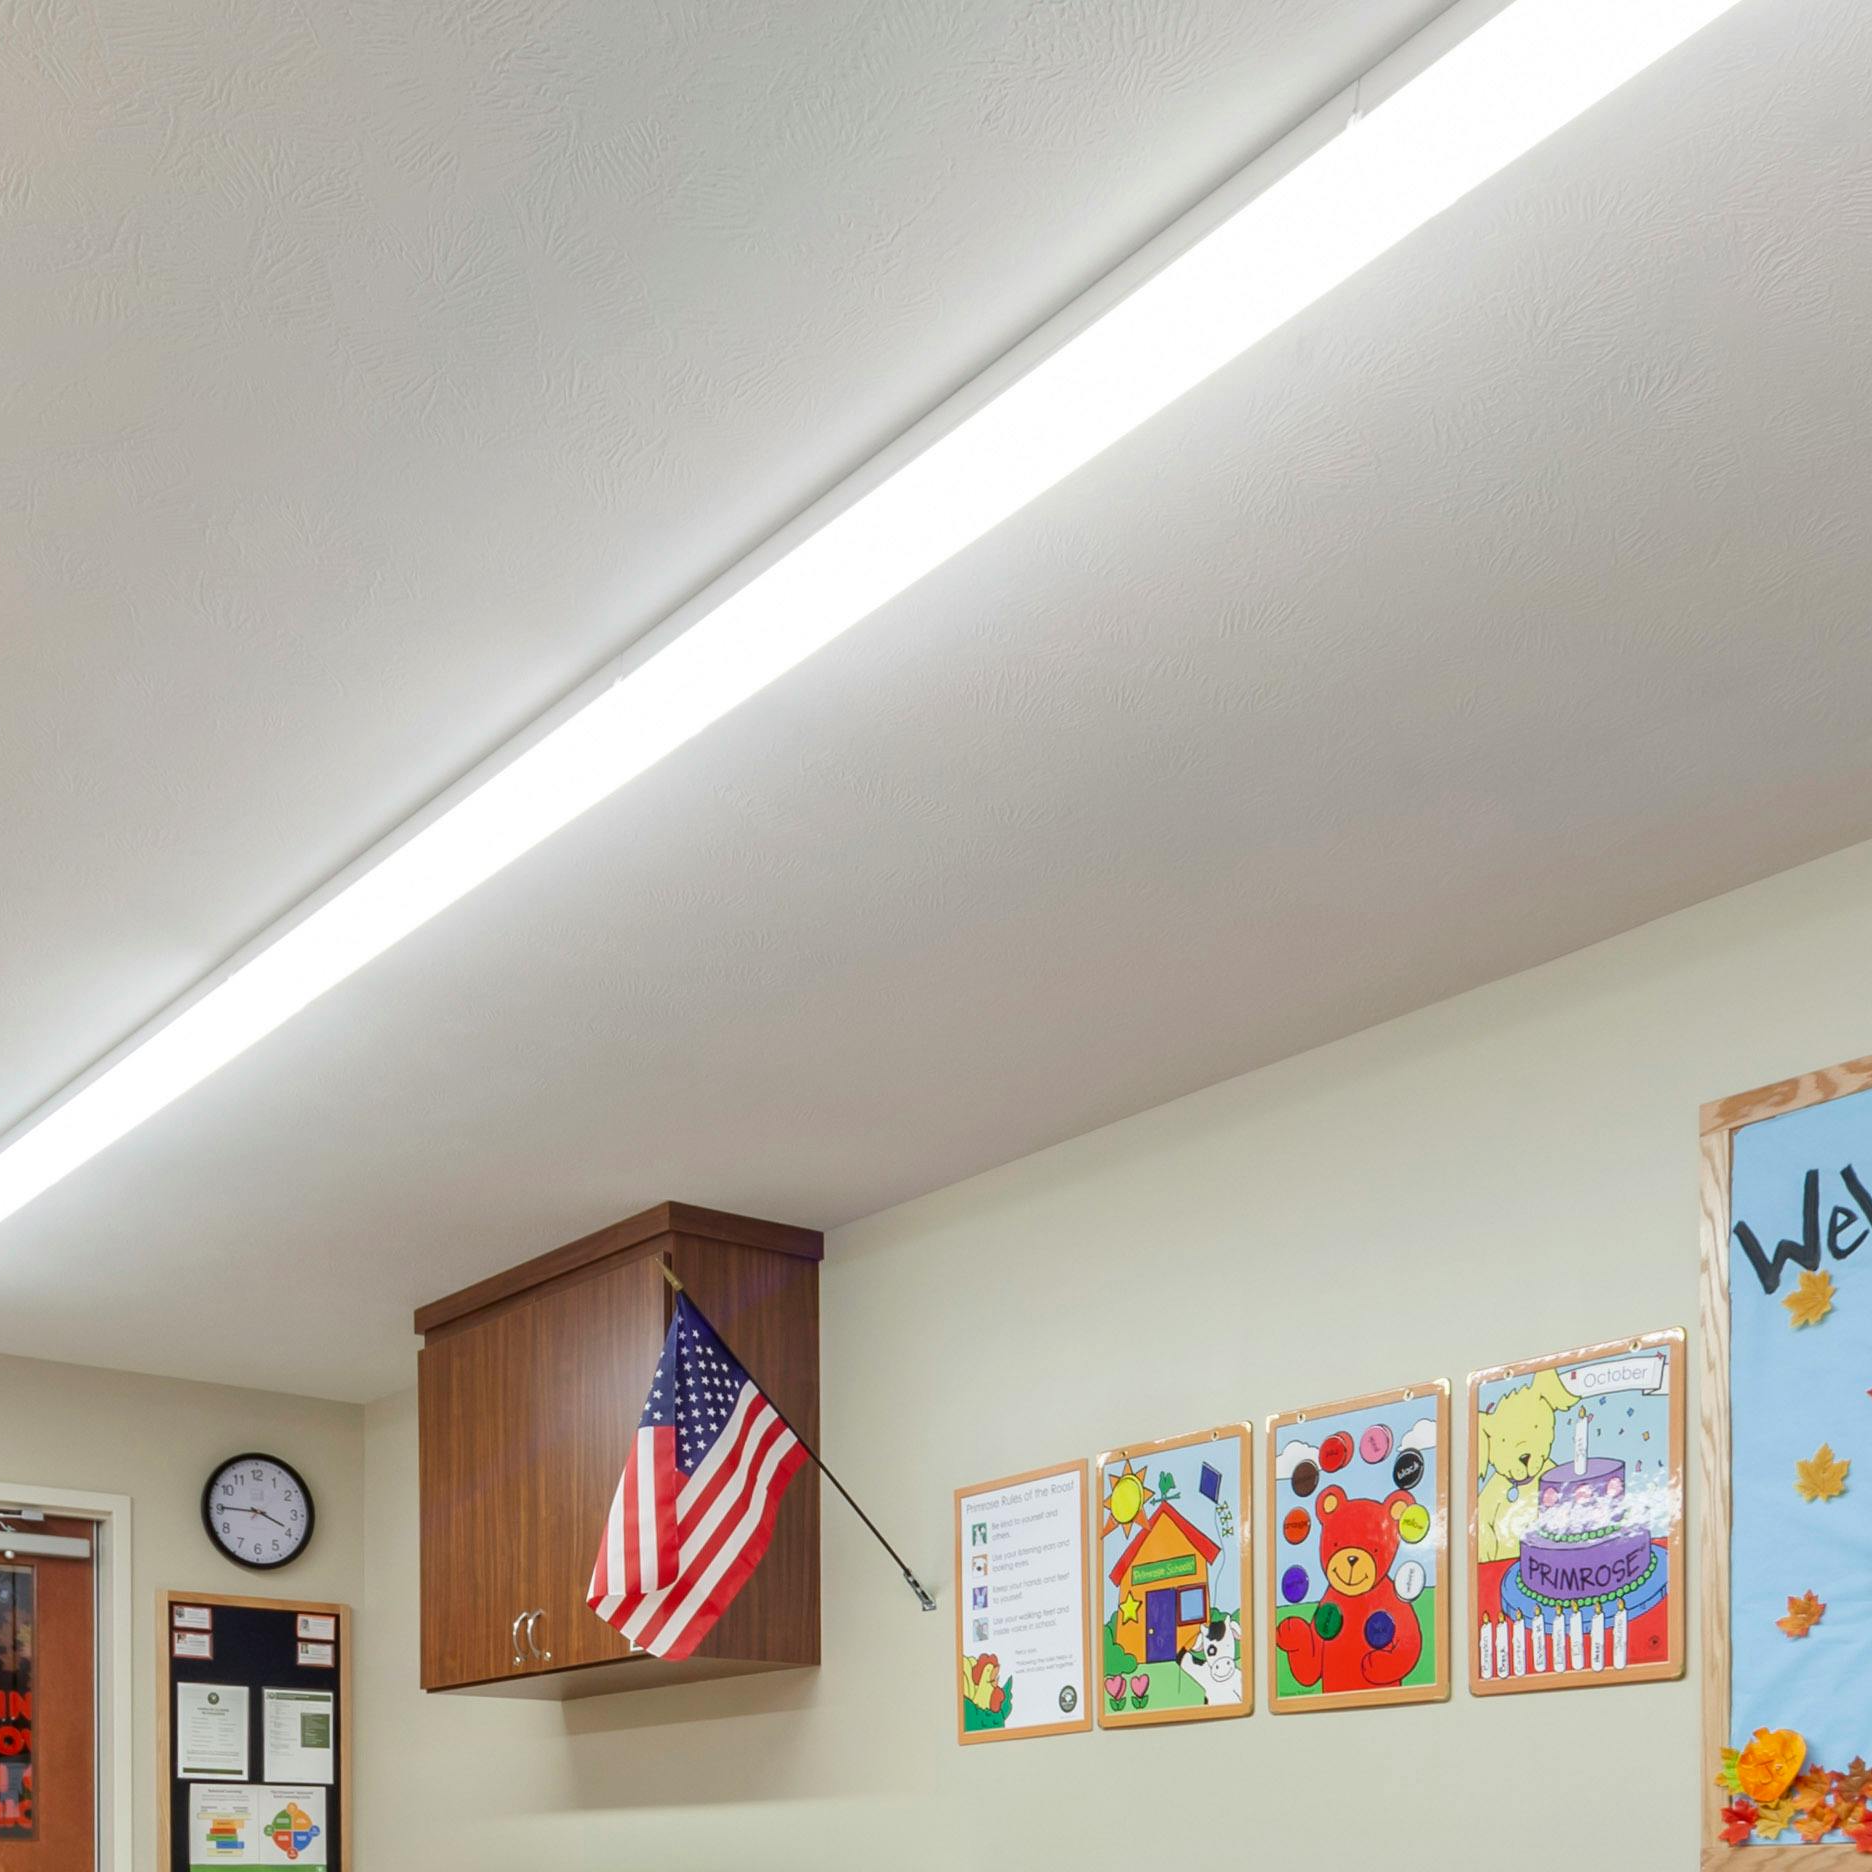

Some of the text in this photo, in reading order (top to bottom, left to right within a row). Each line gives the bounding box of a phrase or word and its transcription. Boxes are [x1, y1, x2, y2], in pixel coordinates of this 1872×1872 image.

[1583, 1366, 1648, 1388] October
[234, 1474, 244, 1486] 11
[252, 1470, 264, 1481] 12
[272, 1478, 276, 1488] 1
[222, 1484, 234, 1496] 10
[284, 1490, 292, 1502] 2
[1002, 1494, 1023, 1506] Rules
[1035, 1488, 1048, 1498] the
[216, 1504, 224, 1515] 9
[290, 1510, 298, 1521] 3
[222, 1522, 230, 1534] 8
[285, 1528, 292, 1538] 4
[237, 1537, 244, 1548] 7
[272, 1540, 279, 1551] 5
[254, 1543, 262, 1554] 6
[1528, 1553, 1640, 1591] PRIMROSE
